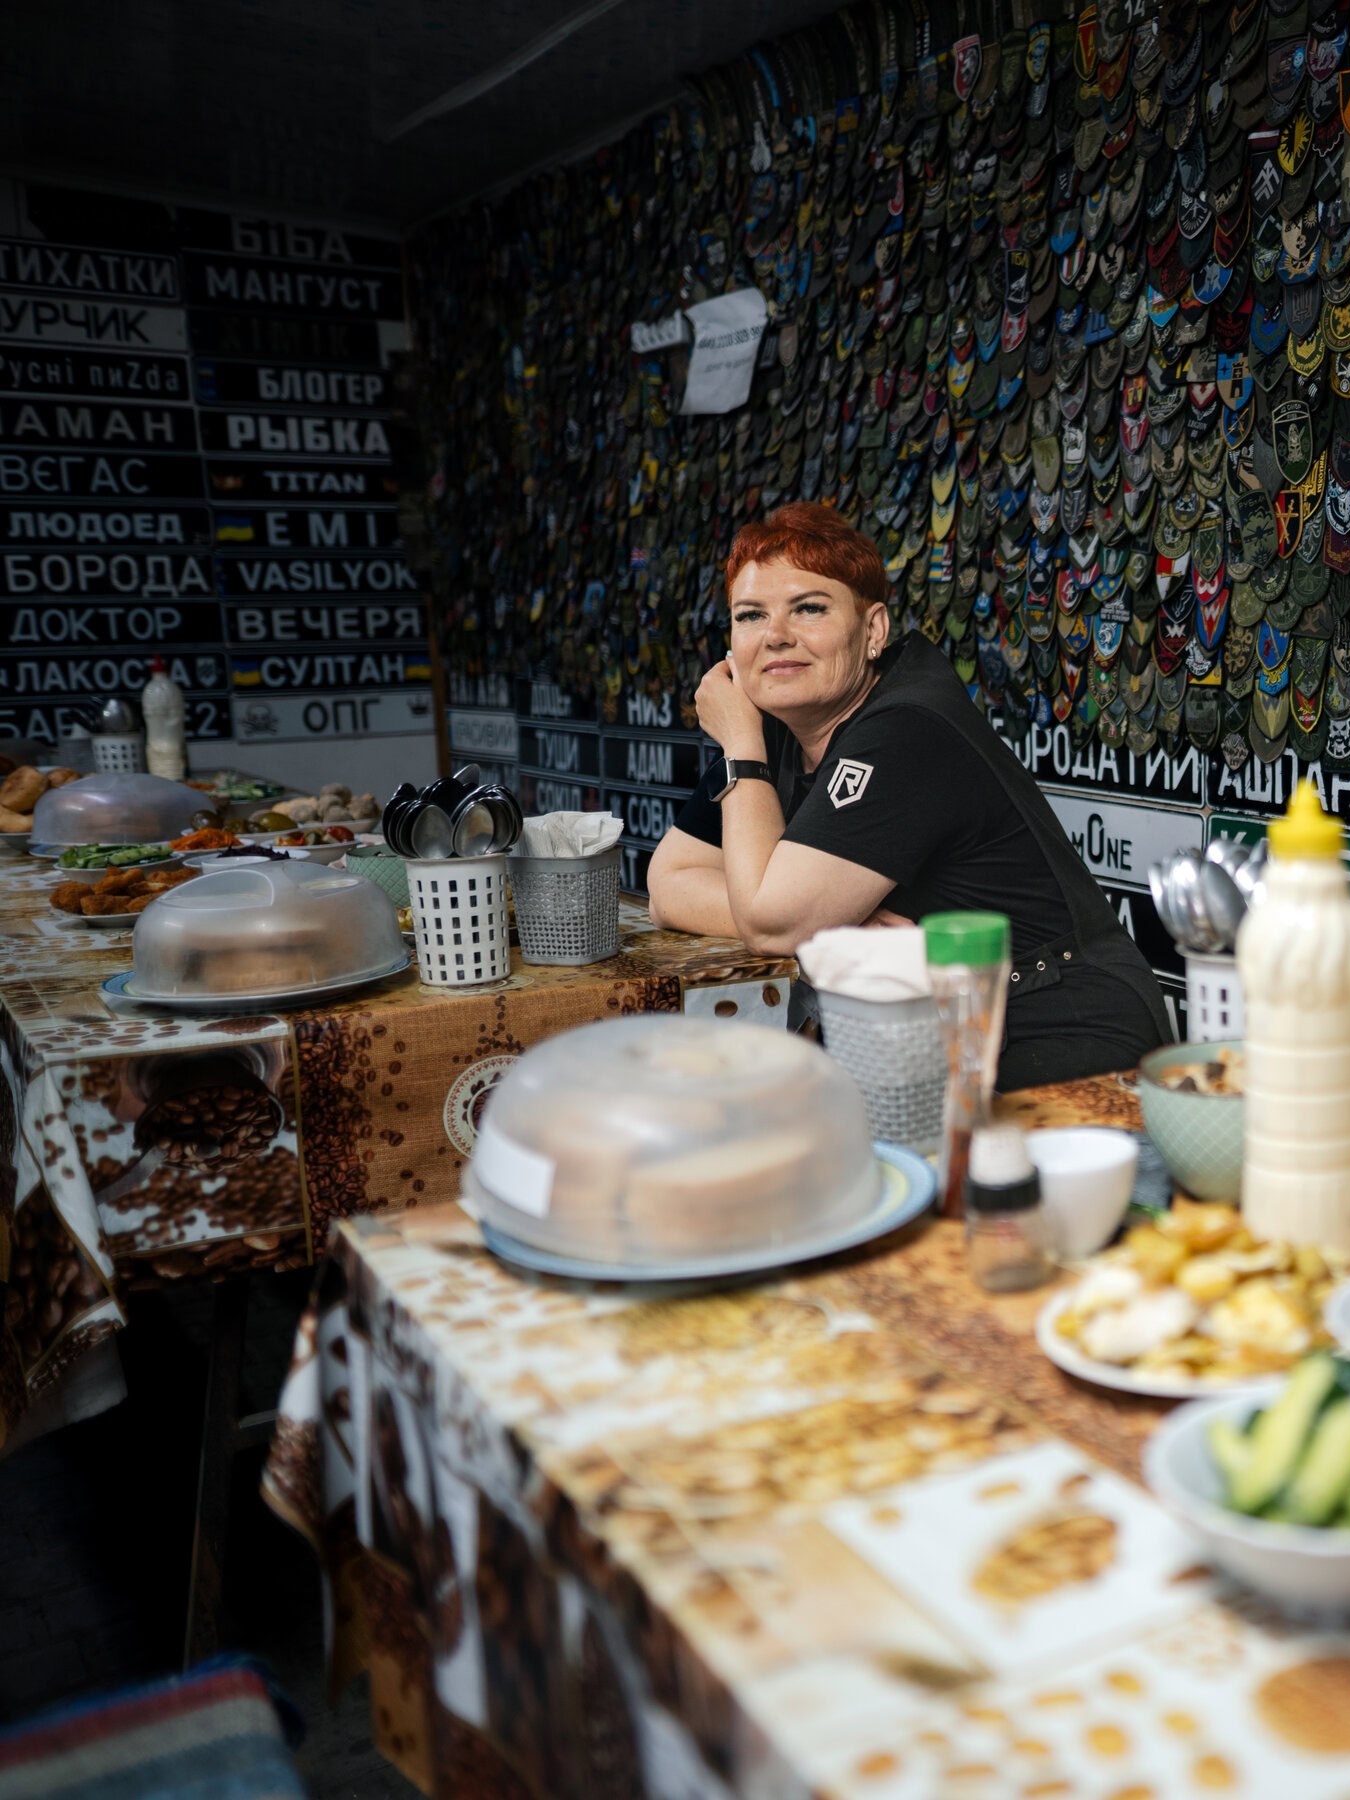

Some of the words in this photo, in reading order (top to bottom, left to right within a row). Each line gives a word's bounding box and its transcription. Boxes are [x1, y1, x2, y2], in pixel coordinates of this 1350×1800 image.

[205, 264, 384, 313] МАНГУСТ
[0, 356, 75, 389] усні
[256, 366, 385, 406] БЛОГЕР
[0, 403, 175, 443] АМАН
[226, 413, 391, 456] РЫБКА
[263, 469, 367, 494] TITAN
[8, 511, 185, 545] ЛЮДОЕД
[3, 553, 211, 599] БОРОДА
[8, 605, 184, 644] ДОКТОР
[236, 606, 421, 643] ВЕЧЕРЯ
[260, 651, 407, 689] СУЛТАН
[302, 697, 381, 734] ОПГ
[627, 740, 674, 786] АДАМ
[990, 717, 1201, 795] ОРОДАТИ
